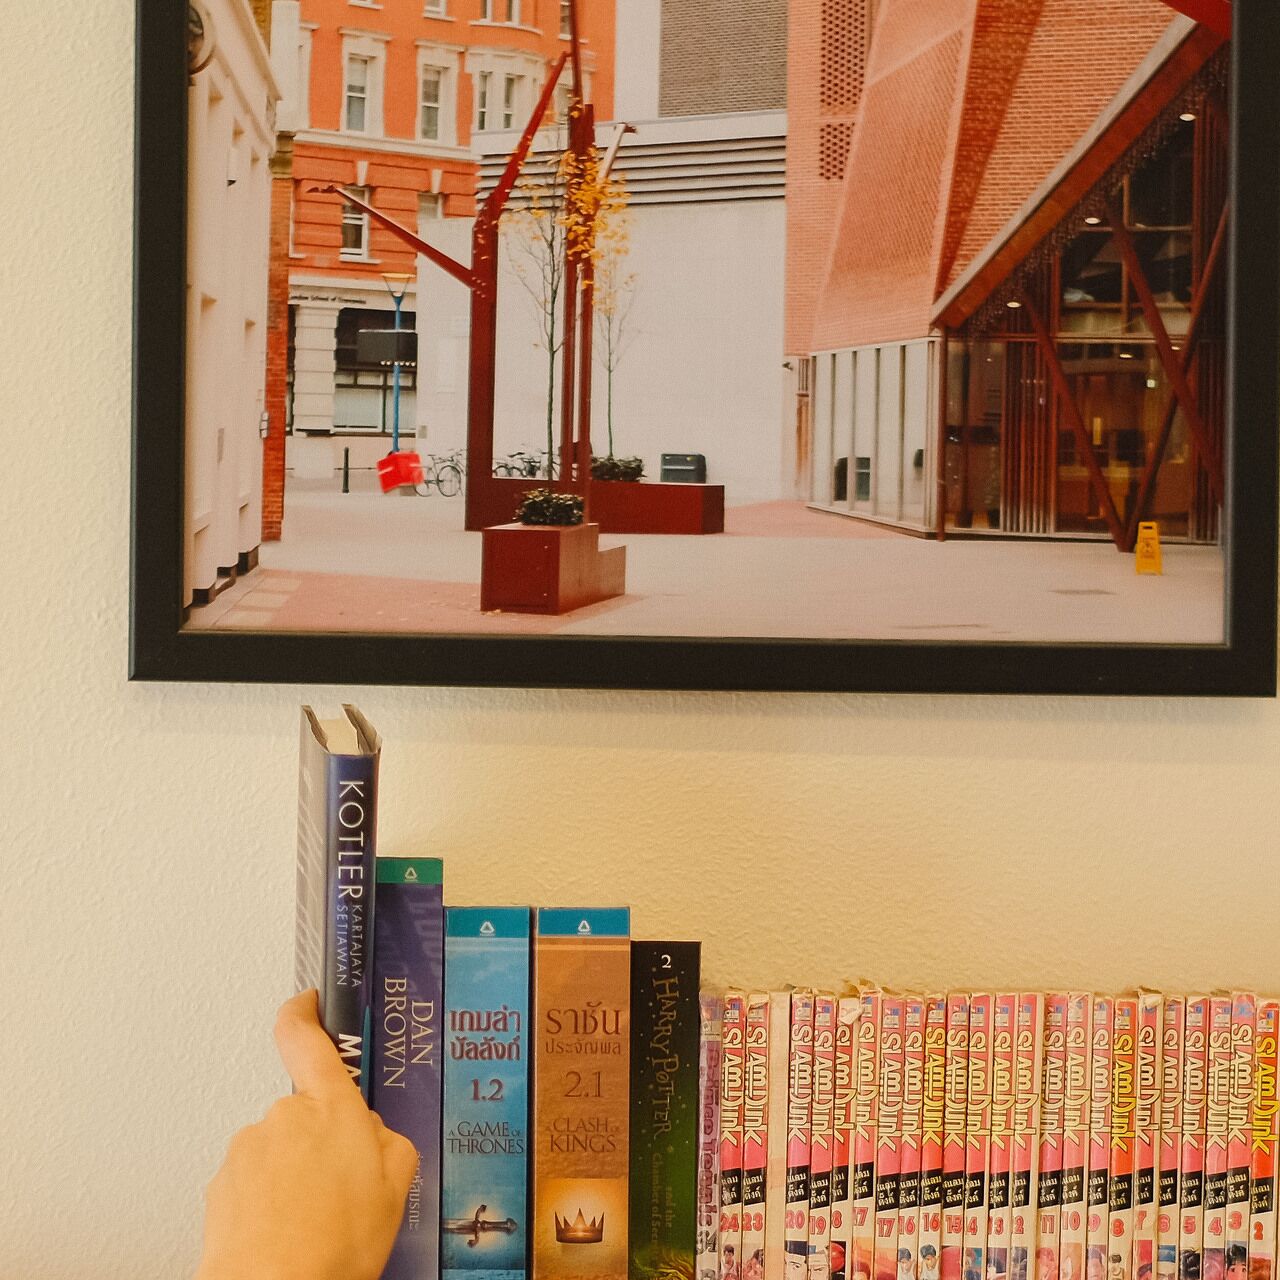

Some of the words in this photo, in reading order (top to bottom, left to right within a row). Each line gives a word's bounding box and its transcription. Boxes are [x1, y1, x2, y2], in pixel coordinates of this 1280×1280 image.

[338, 780, 365, 898] KOTLER
[336, 904, 348, 986] SETIAWAN
[350, 904, 363, 988] KARTAJAYA
[661, 954, 672, 969] 2
[450, 1004, 522, 1032] เกมล่า
[545, 1001, 622, 1036] ราชัน
[652, 976, 679, 1052] HARRY
[383, 977, 407, 1089] BROWN
[410, 1000, 433, 1066] DAN
[470, 1078, 504, 1102] 1.2
[563, 1071, 603, 1099] 2.1
[651, 1053, 680, 1140] POTTER
[456, 1121, 510, 1138] GAME
[552, 1117, 610, 1134] CLASH
[448, 1138, 524, 1155] THRONES
[548, 1135, 618, 1154] KINGS
[877, 1218, 895, 1237] 17
[923, 1212, 940, 1232] 16
[945, 1215, 962, 1234] 15
[1110, 1218, 1125, 1238] 8
[1183, 1215, 1196, 1234] 5
[1228, 1210, 1242, 1230] 3
[1253, 1221, 1264, 1241] 2
